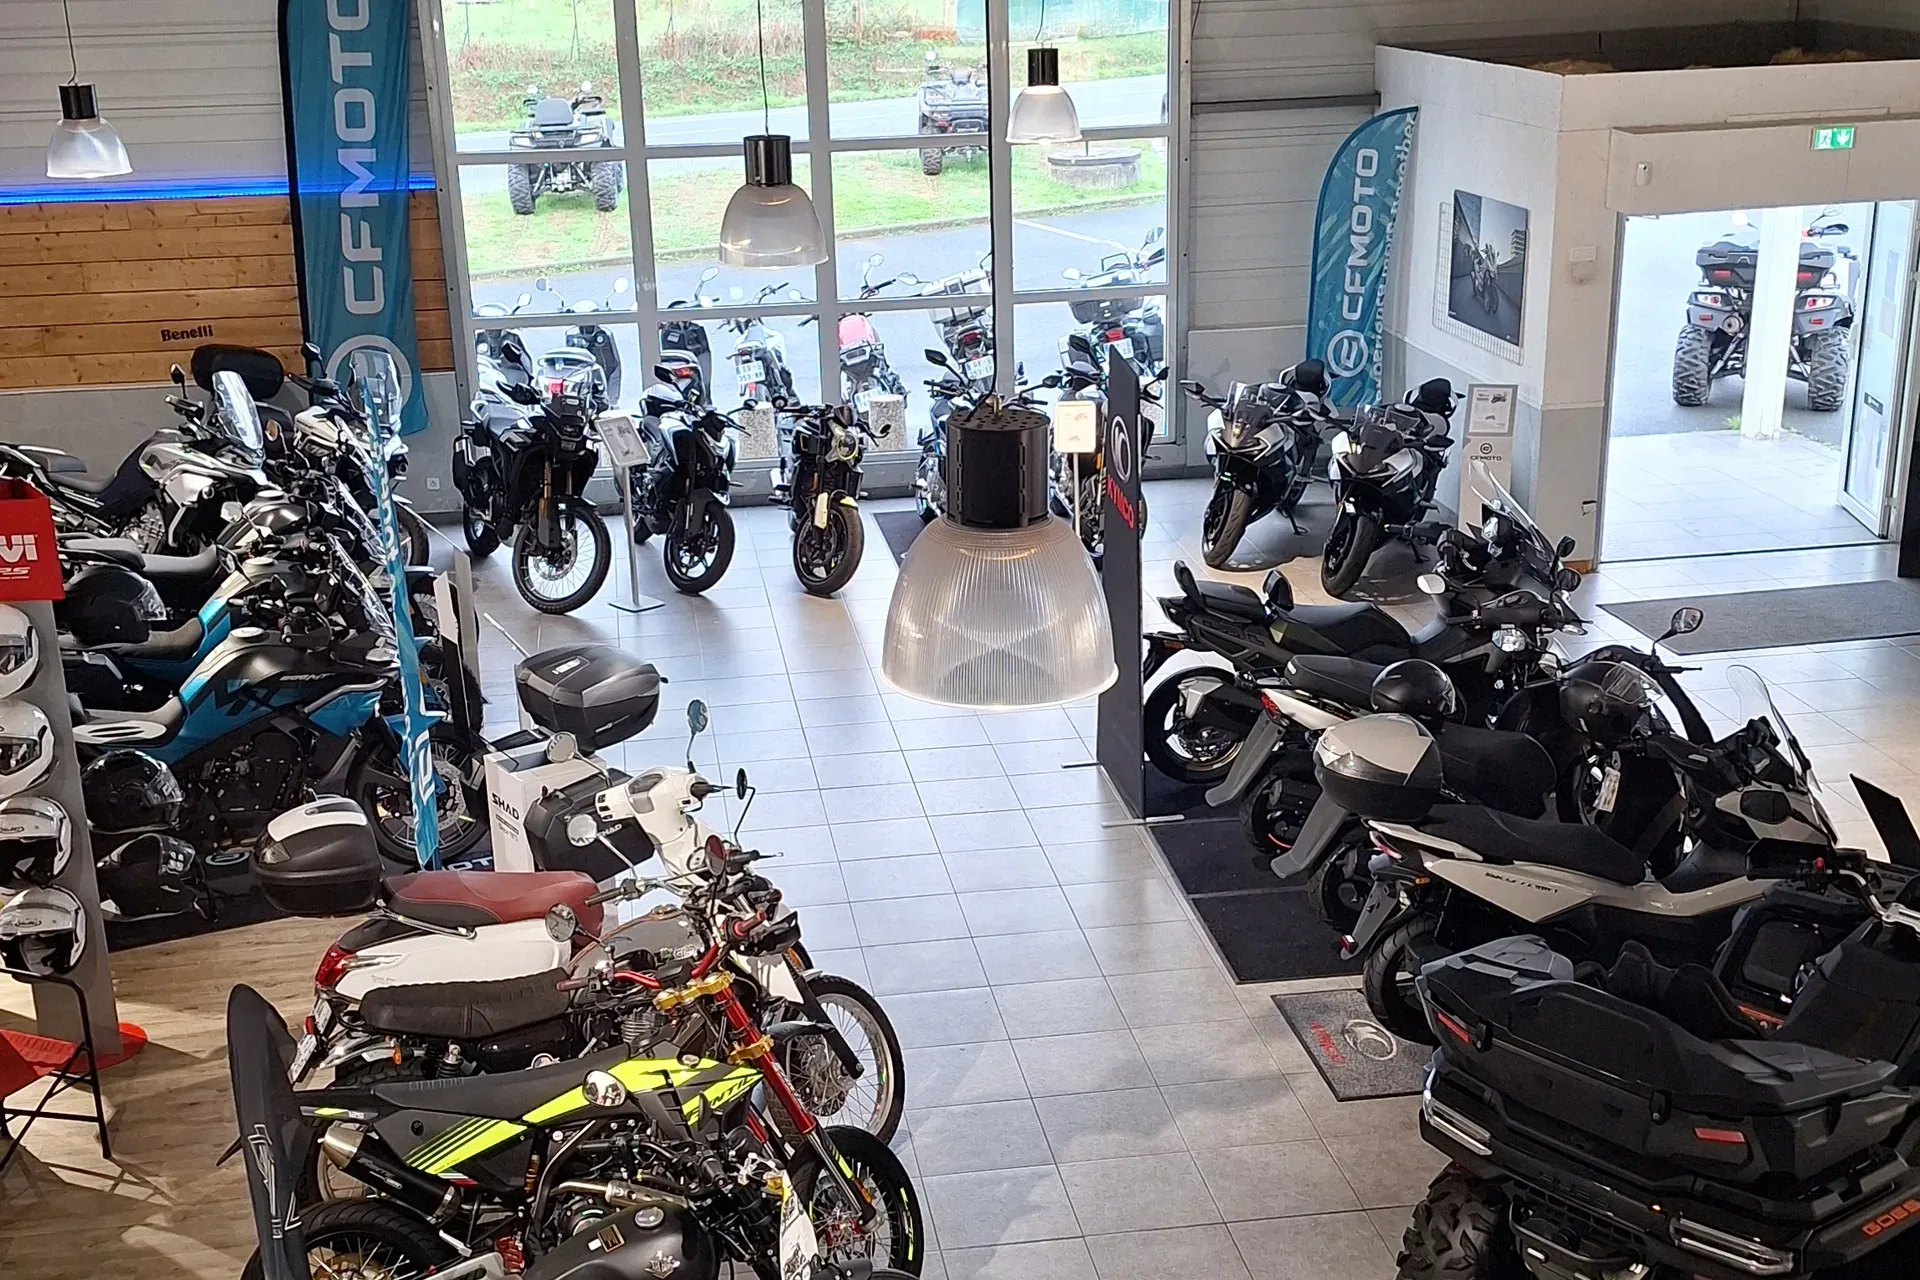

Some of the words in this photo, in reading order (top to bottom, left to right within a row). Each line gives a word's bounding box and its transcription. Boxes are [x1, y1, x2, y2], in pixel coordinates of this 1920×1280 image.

[1342, 148, 1379, 321] CFMOTO
[161, 324, 214, 342] Benelli
[1106, 474, 1134, 529] KYMCO
[491, 792, 520, 821] SHAD
